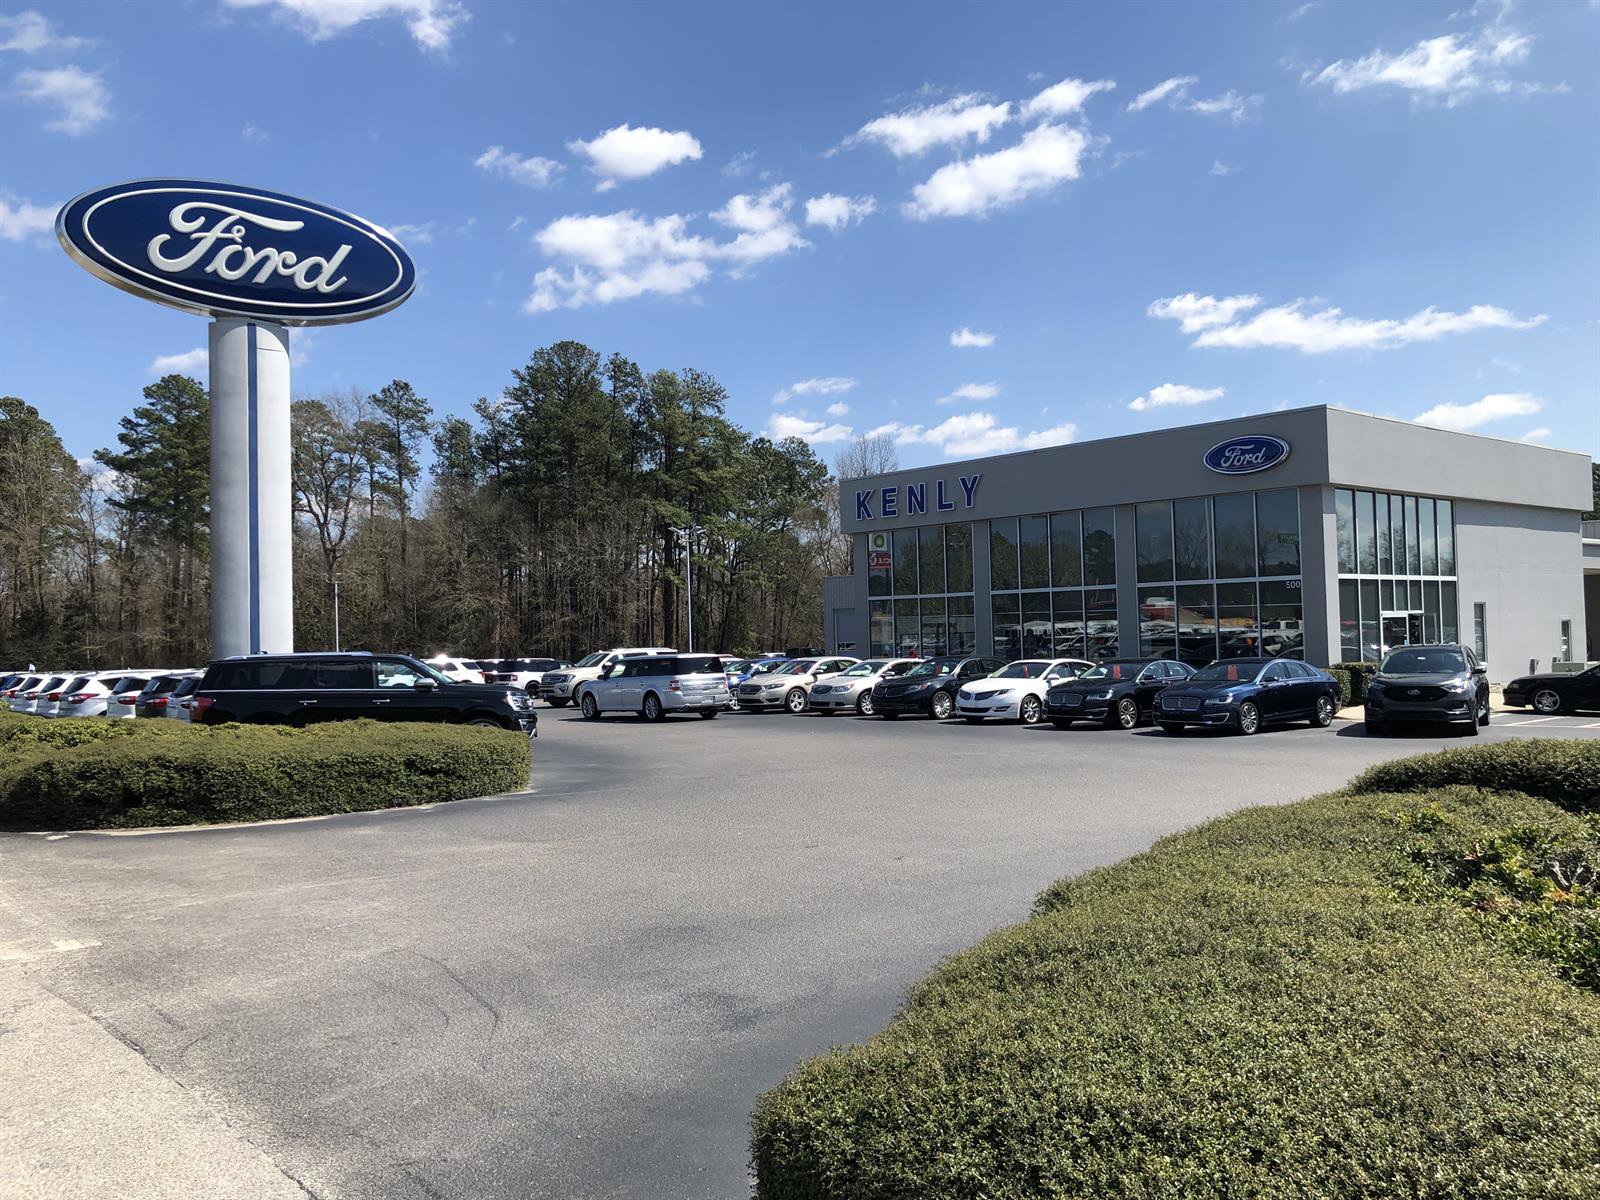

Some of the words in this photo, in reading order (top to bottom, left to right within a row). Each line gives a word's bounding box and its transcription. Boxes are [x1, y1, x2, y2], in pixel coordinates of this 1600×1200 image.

[147, 201, 353, 294] Ford
[1220, 444, 1267, 468] Ford
[856, 474, 980, 520] KENLY
[1285, 580, 1301, 589] 500
